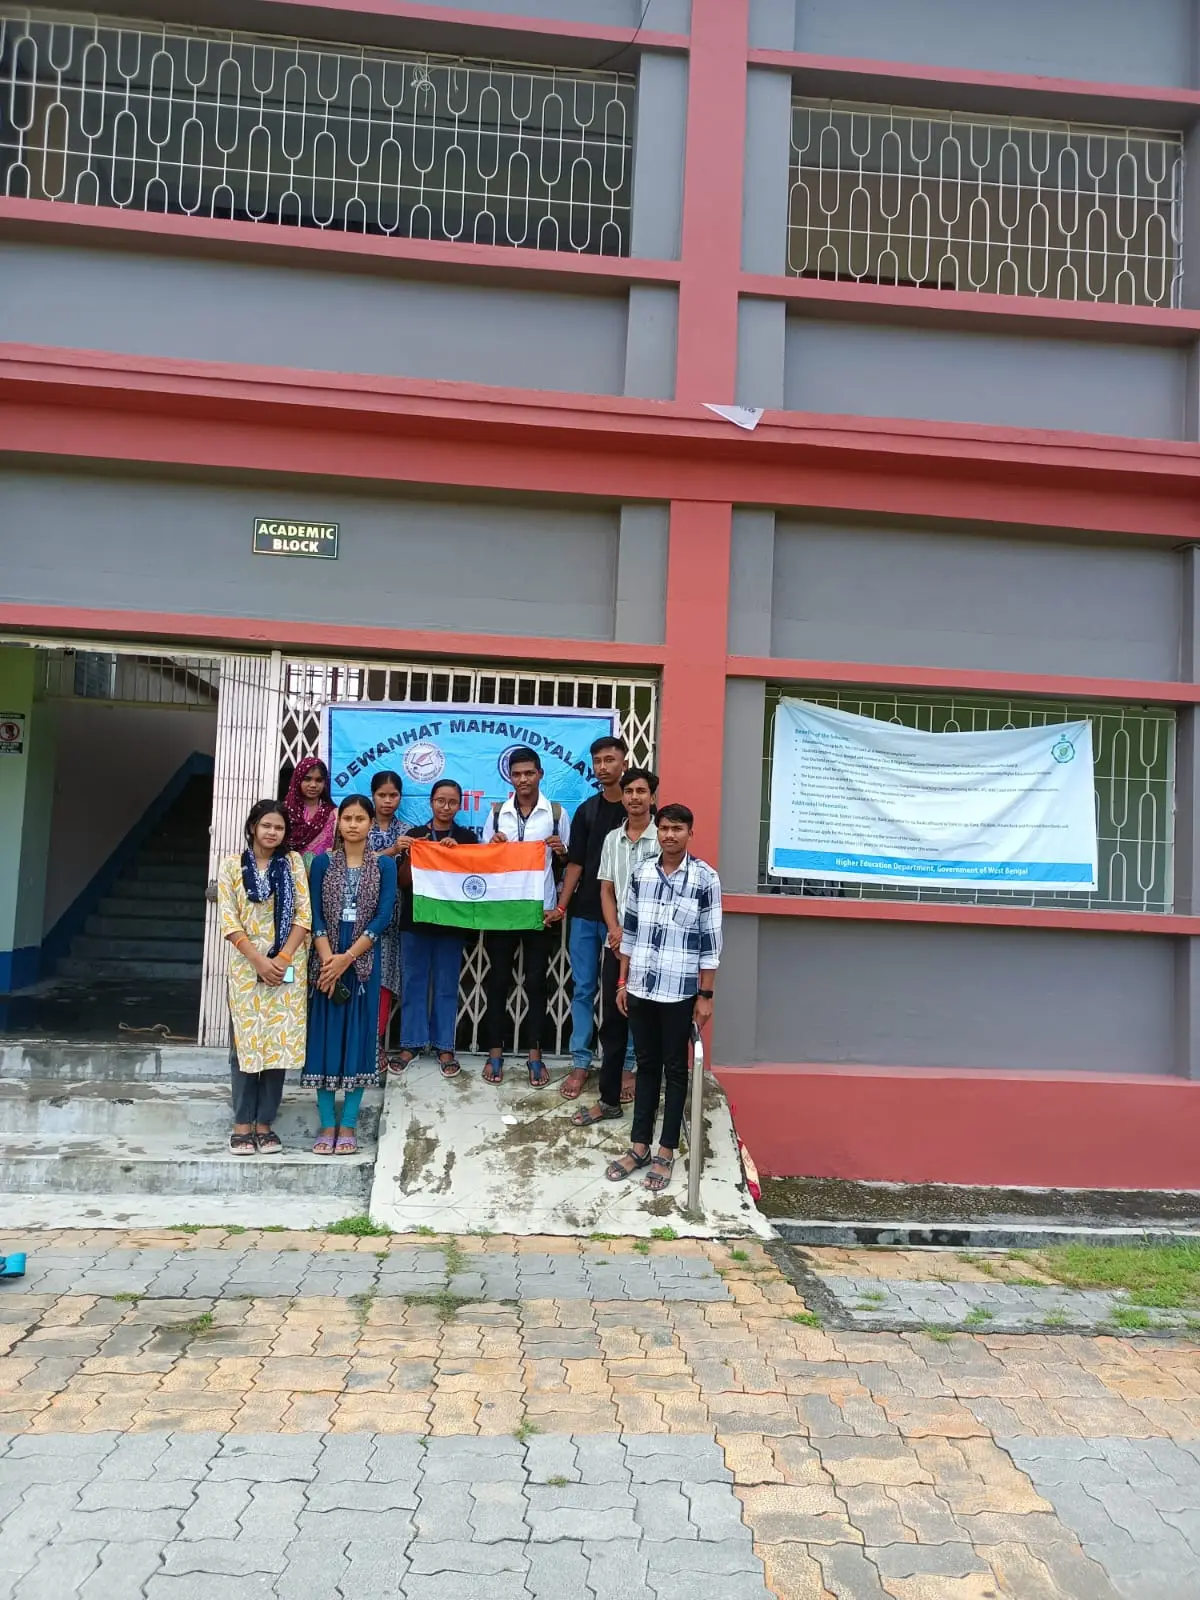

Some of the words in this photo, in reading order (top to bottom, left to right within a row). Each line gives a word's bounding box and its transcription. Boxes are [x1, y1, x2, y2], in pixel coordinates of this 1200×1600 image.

[258, 523, 334, 540] ACADEMIC
[272, 538, 319, 553] BLOCK
[334, 721, 443, 788] DEWANHAT
[458, 790, 484, 811] IT
[835, 857, 858, 868] Higher
[860, 860, 892, 870] Education
[937, 865, 978, 874] Government
[979, 866, 987, 874] of
[987, 866, 1004, 874] West
[1004, 868, 1029, 876] Bengal
